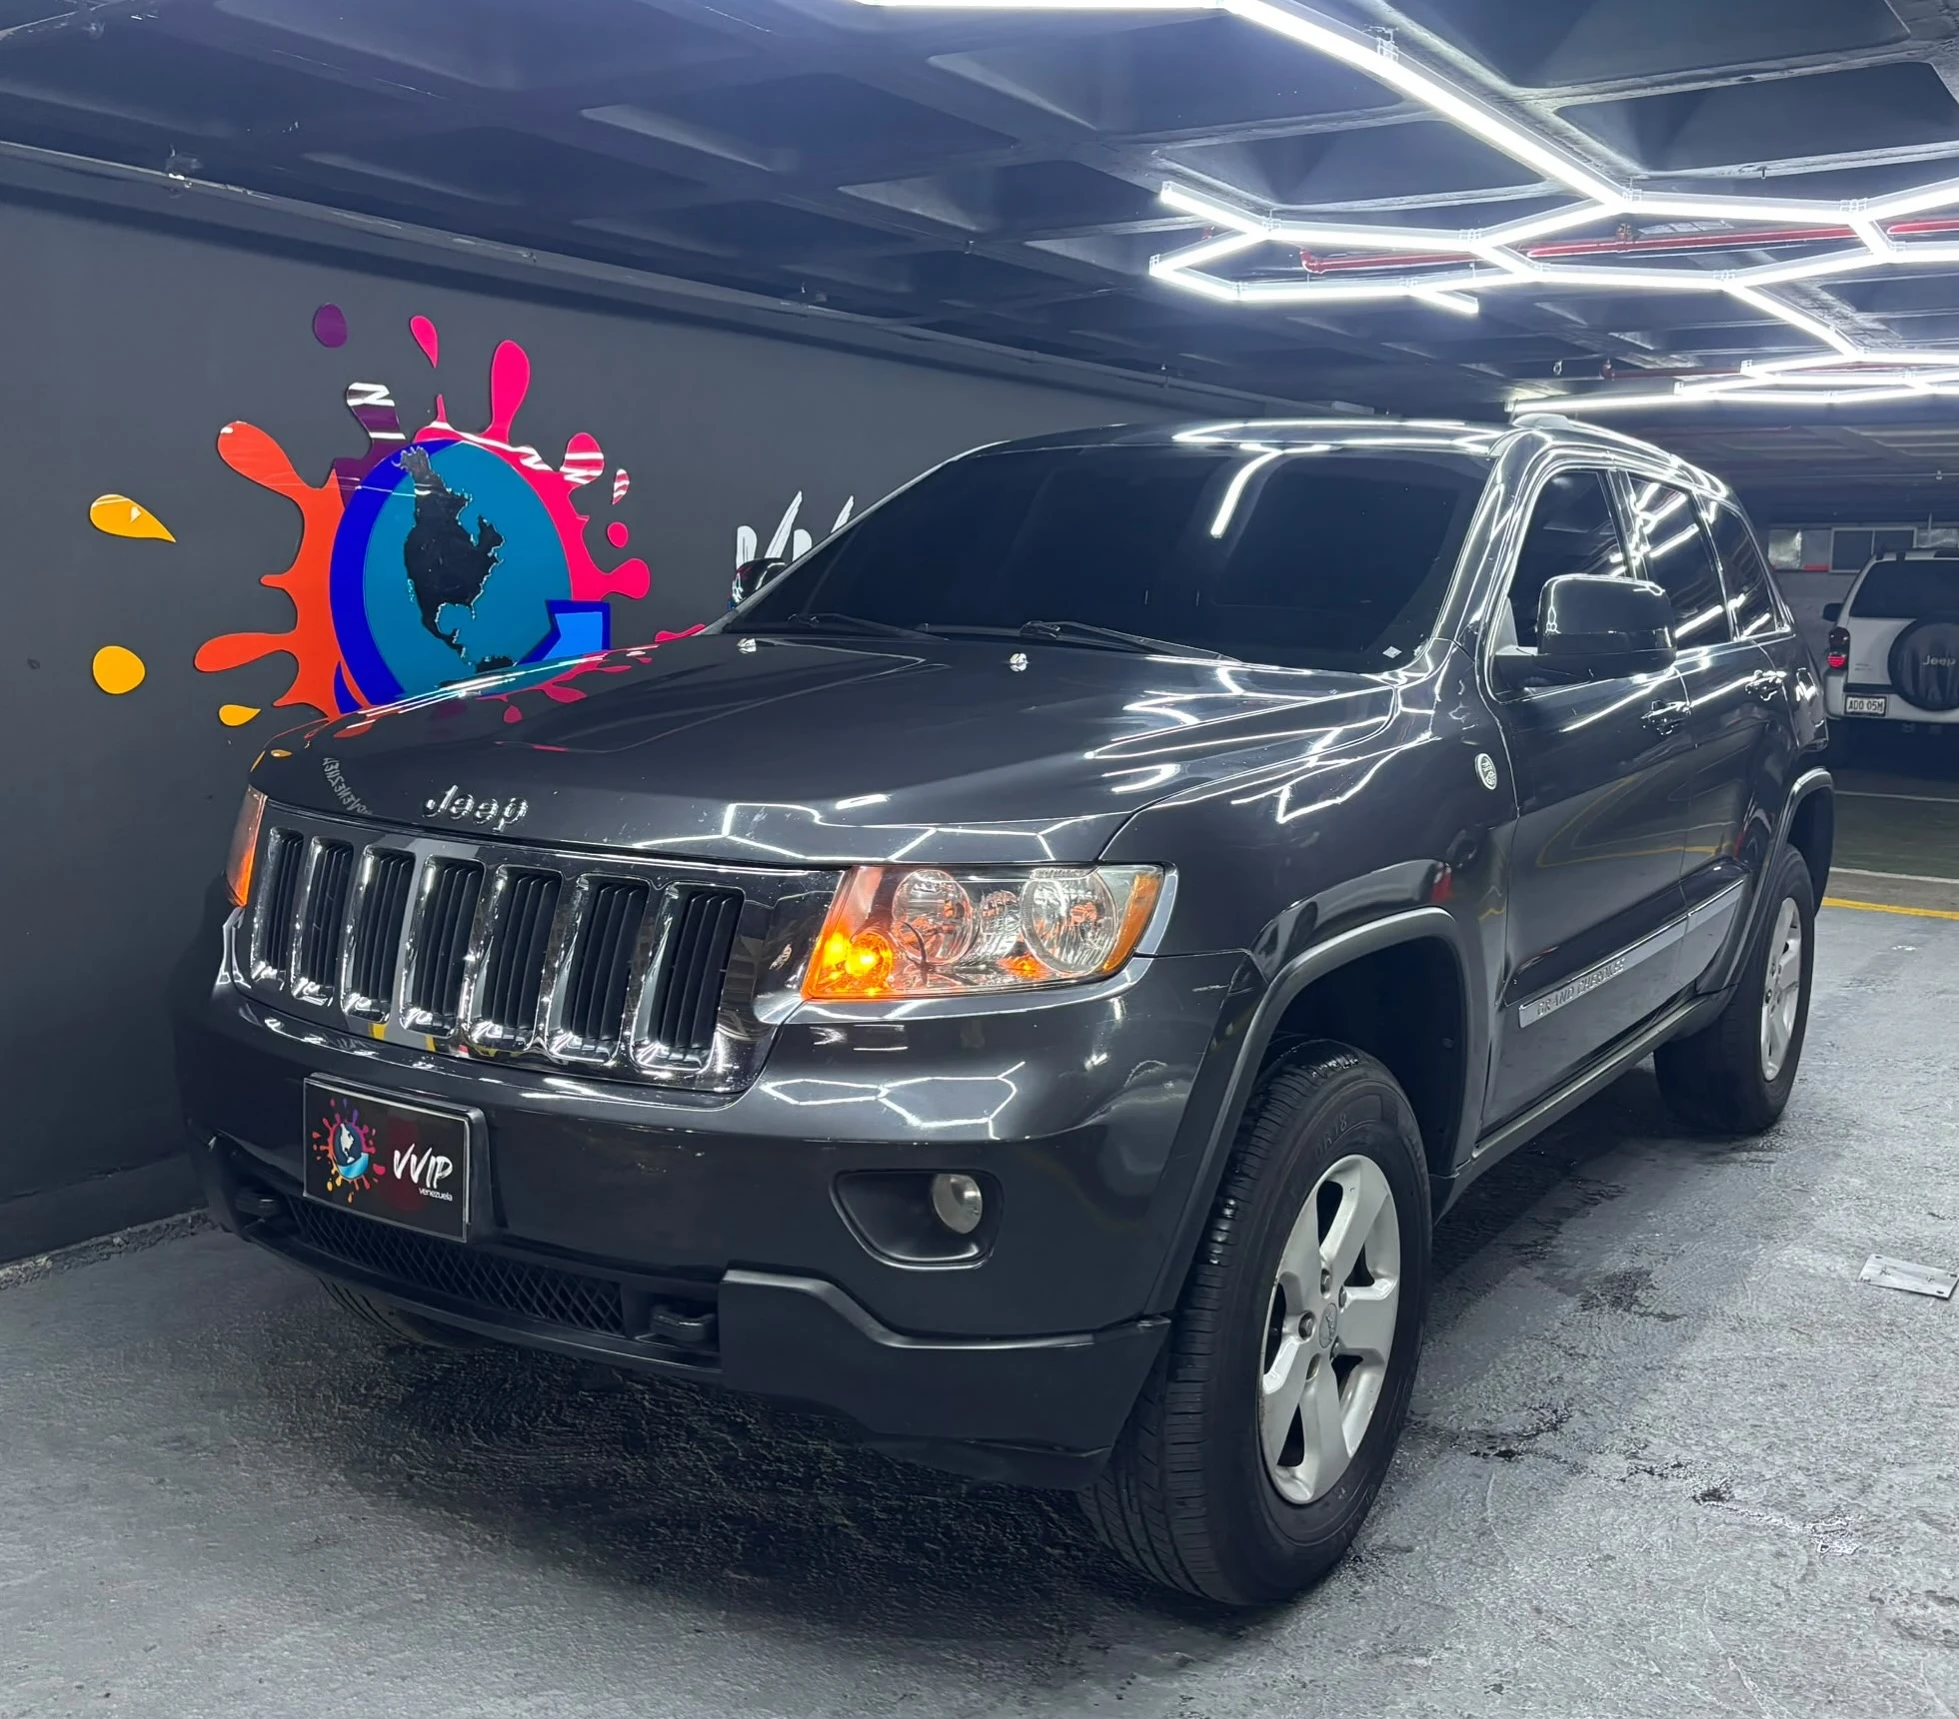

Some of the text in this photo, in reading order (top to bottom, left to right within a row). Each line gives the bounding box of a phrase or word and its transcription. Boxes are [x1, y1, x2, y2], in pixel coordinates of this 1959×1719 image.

[1923, 655, 1957, 668] Jeep
[420, 784, 529, 833] Jeep
[1536, 986, 1575, 1017] GRAND
[393, 1143, 454, 1189] VVIP
[418, 1187, 454, 1202] venezuela
